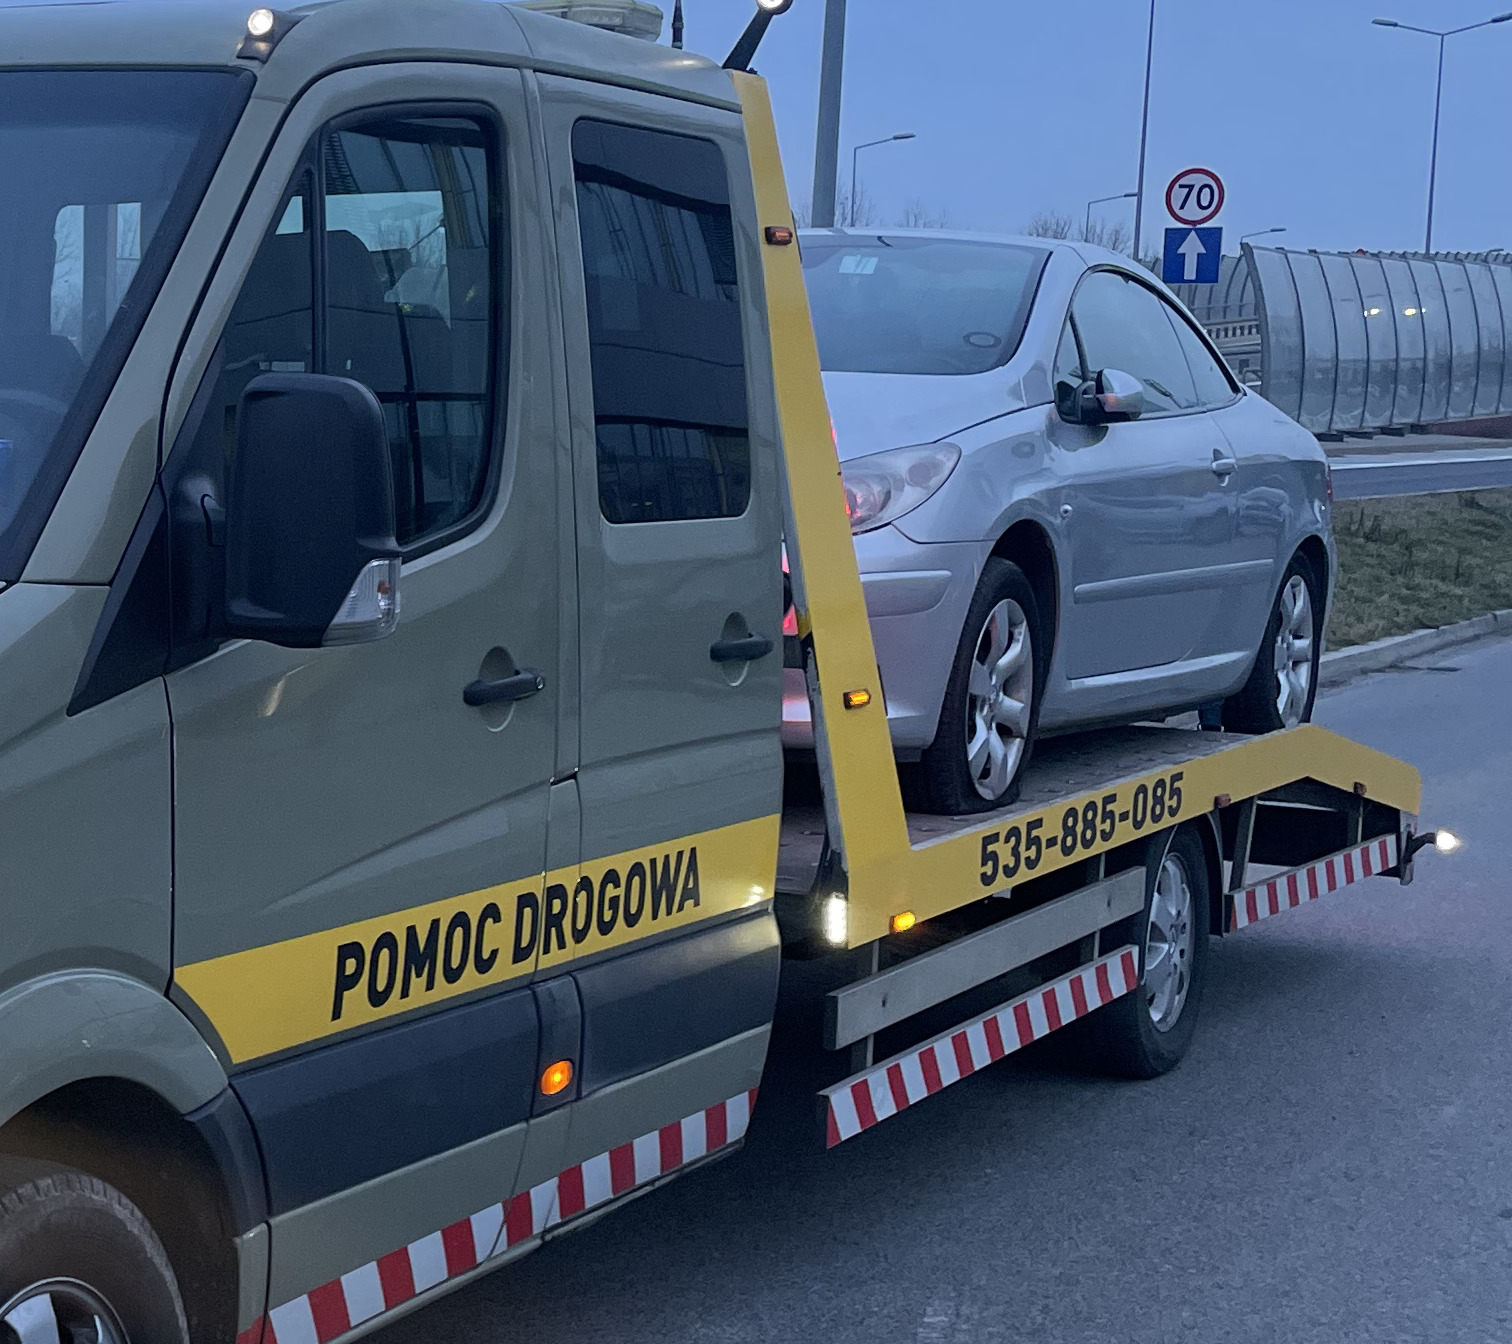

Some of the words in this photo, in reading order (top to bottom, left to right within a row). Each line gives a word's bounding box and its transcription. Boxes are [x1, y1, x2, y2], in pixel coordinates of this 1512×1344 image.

[1177, 182, 1216, 211] 70
[979, 771, 1185, 888] 535-885-085
[330, 901, 502, 1023] POMOC
[511, 845, 701, 966] DROGOWA
